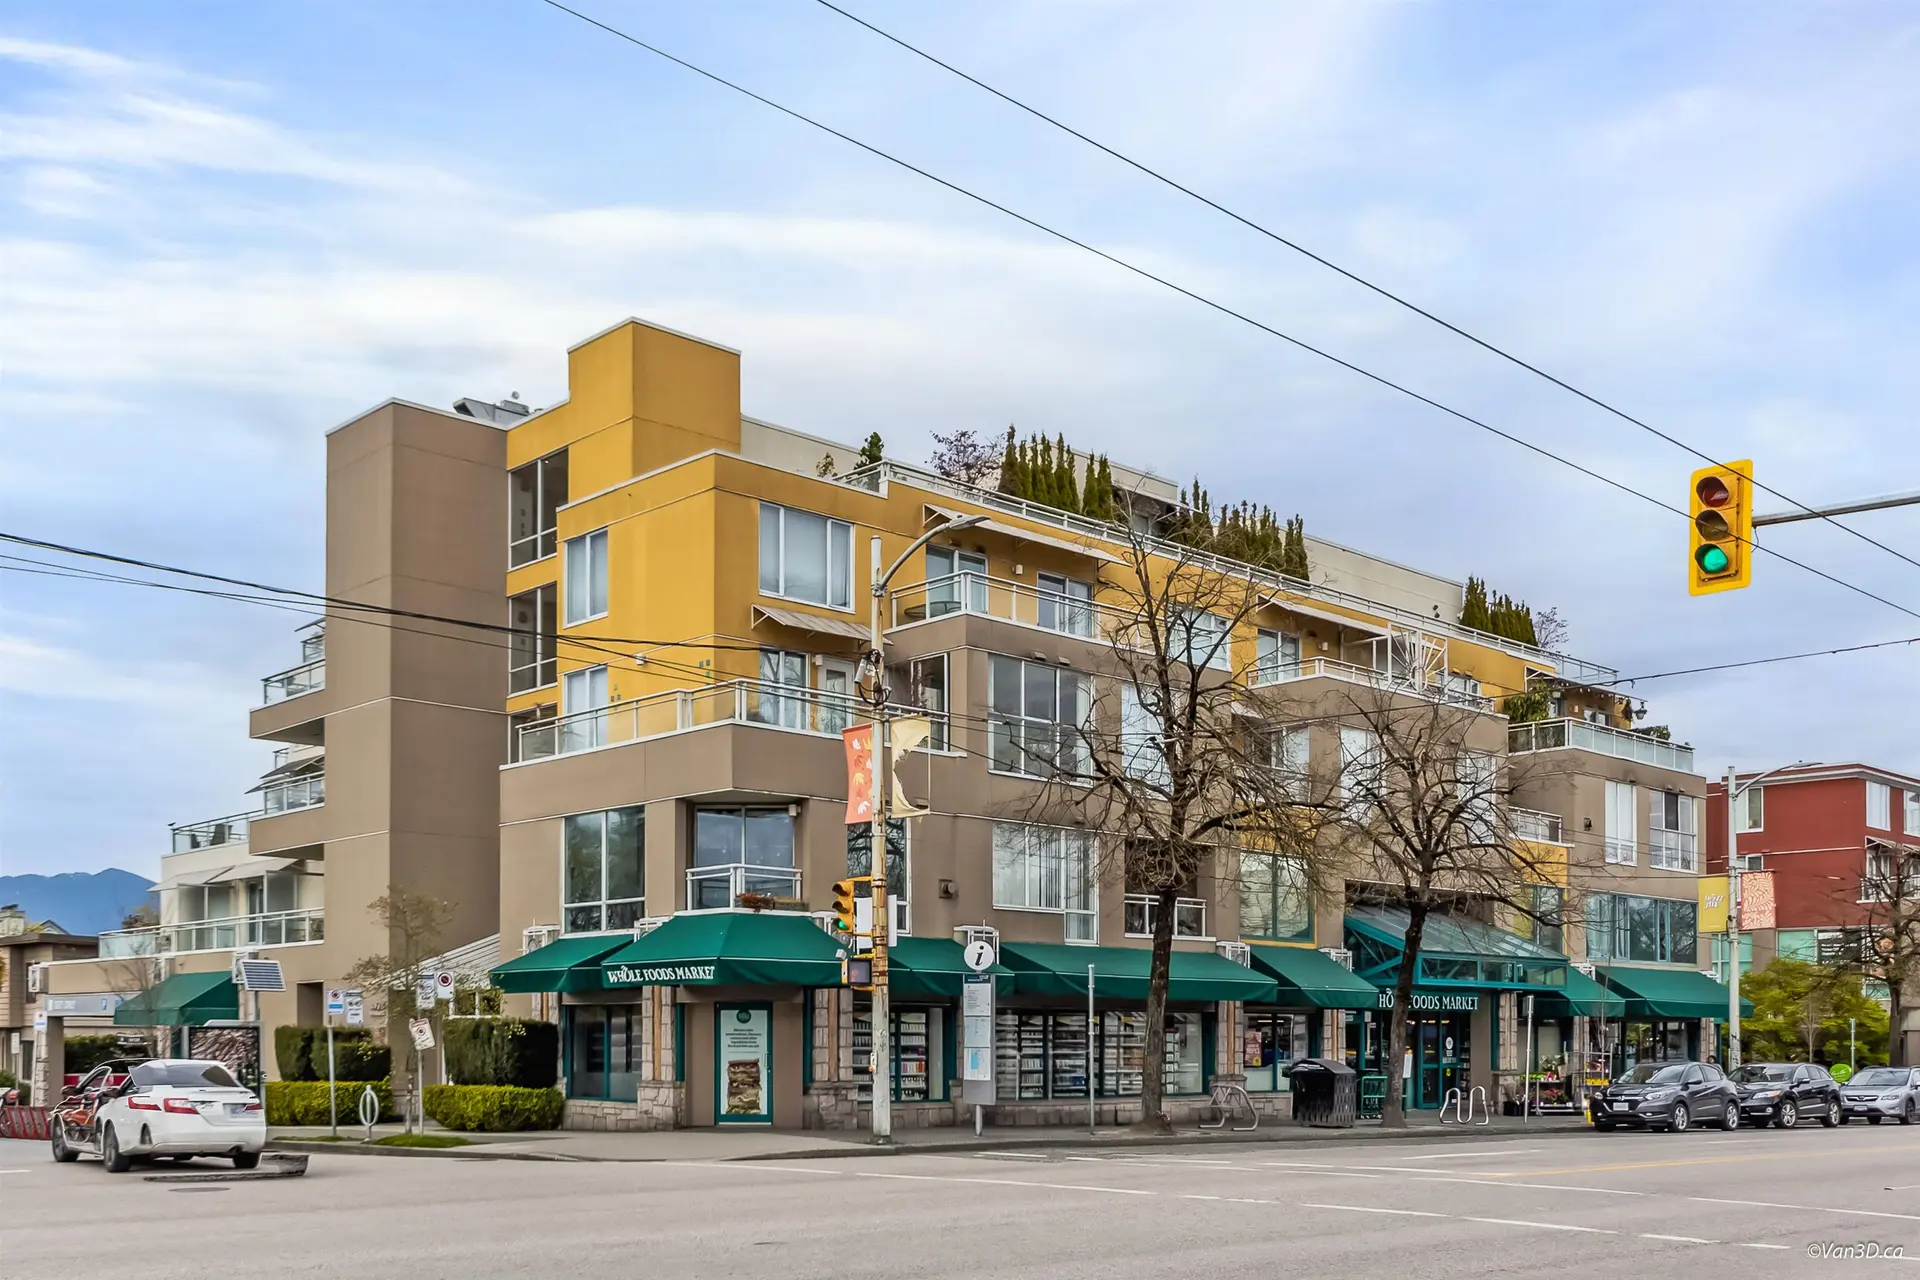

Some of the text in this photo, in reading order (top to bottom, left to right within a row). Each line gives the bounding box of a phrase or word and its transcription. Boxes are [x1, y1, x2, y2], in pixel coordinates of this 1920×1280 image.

[607, 965, 715, 983] WHOLE FOODS MARKET
[1442, 996, 1479, 1010] MARKET
